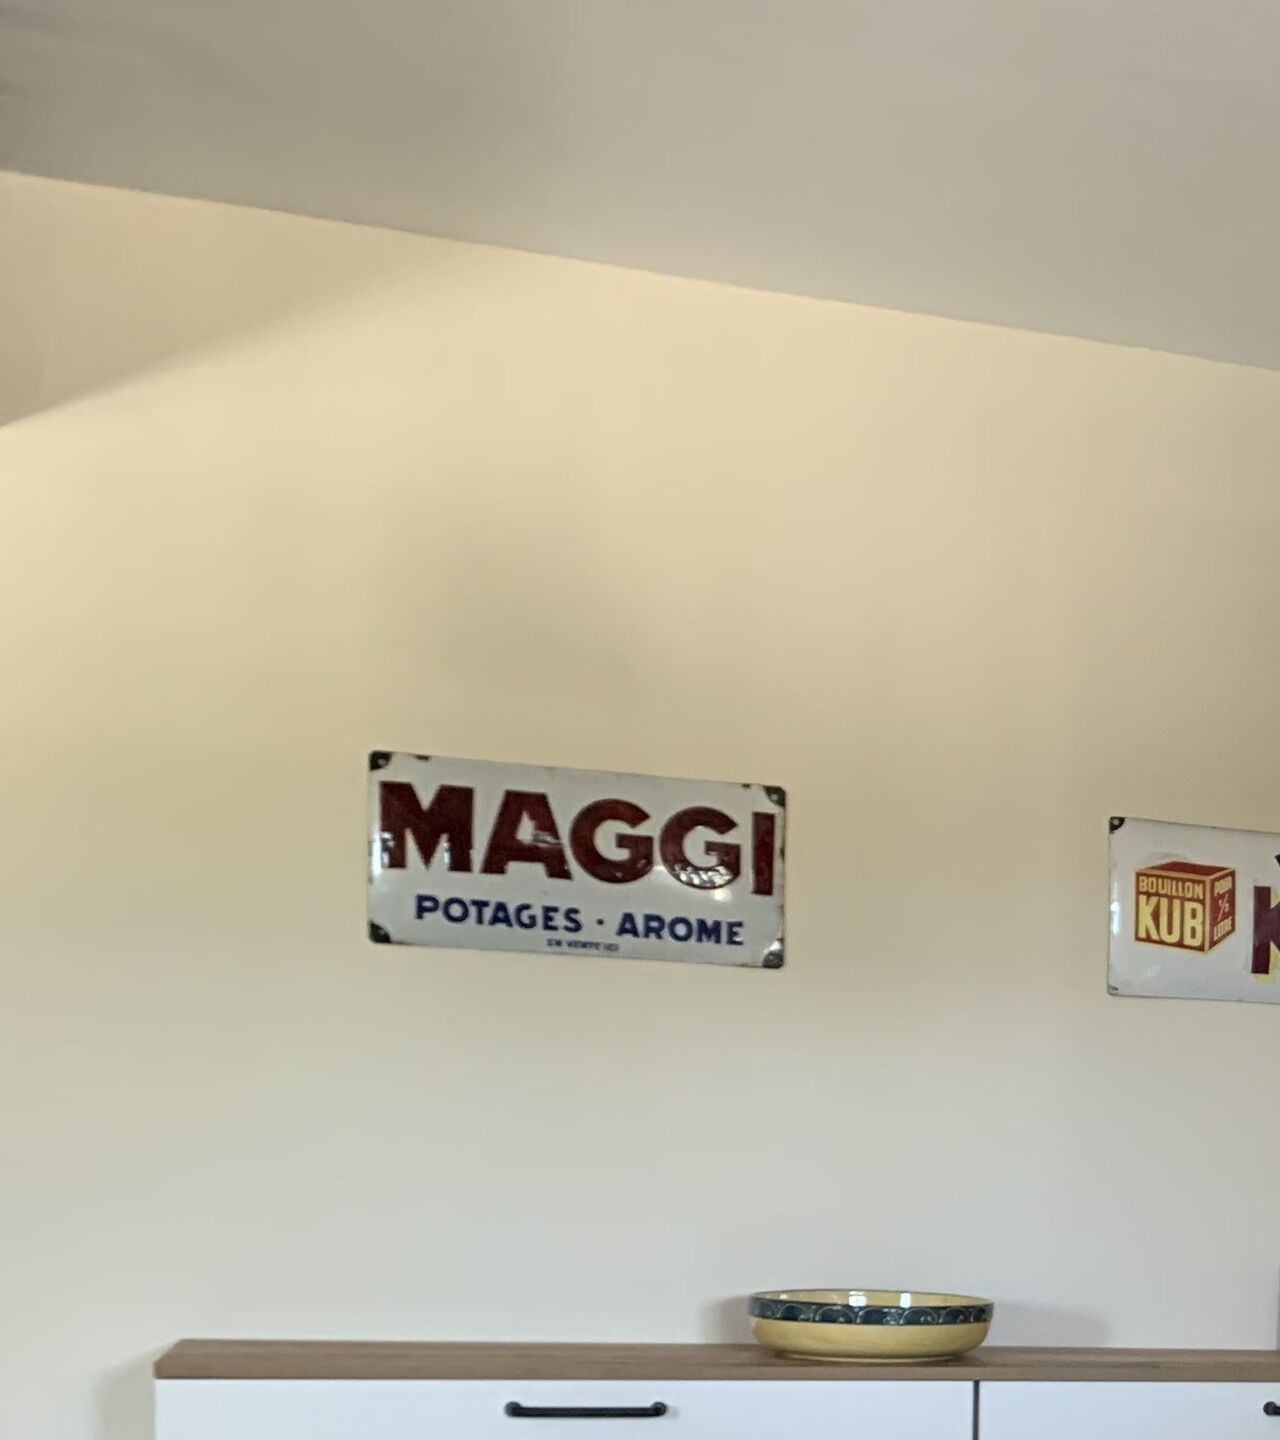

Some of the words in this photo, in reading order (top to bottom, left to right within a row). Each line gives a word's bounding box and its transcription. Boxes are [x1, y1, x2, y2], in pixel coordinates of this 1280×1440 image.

[379, 780, 776, 896] MAGGI
[1139, 875, 1203, 899] BOUILLON
[414, 894, 583, 932] POTAGES
[616, 912, 744, 946] AROME
[1138, 895, 1204, 947] KUB
